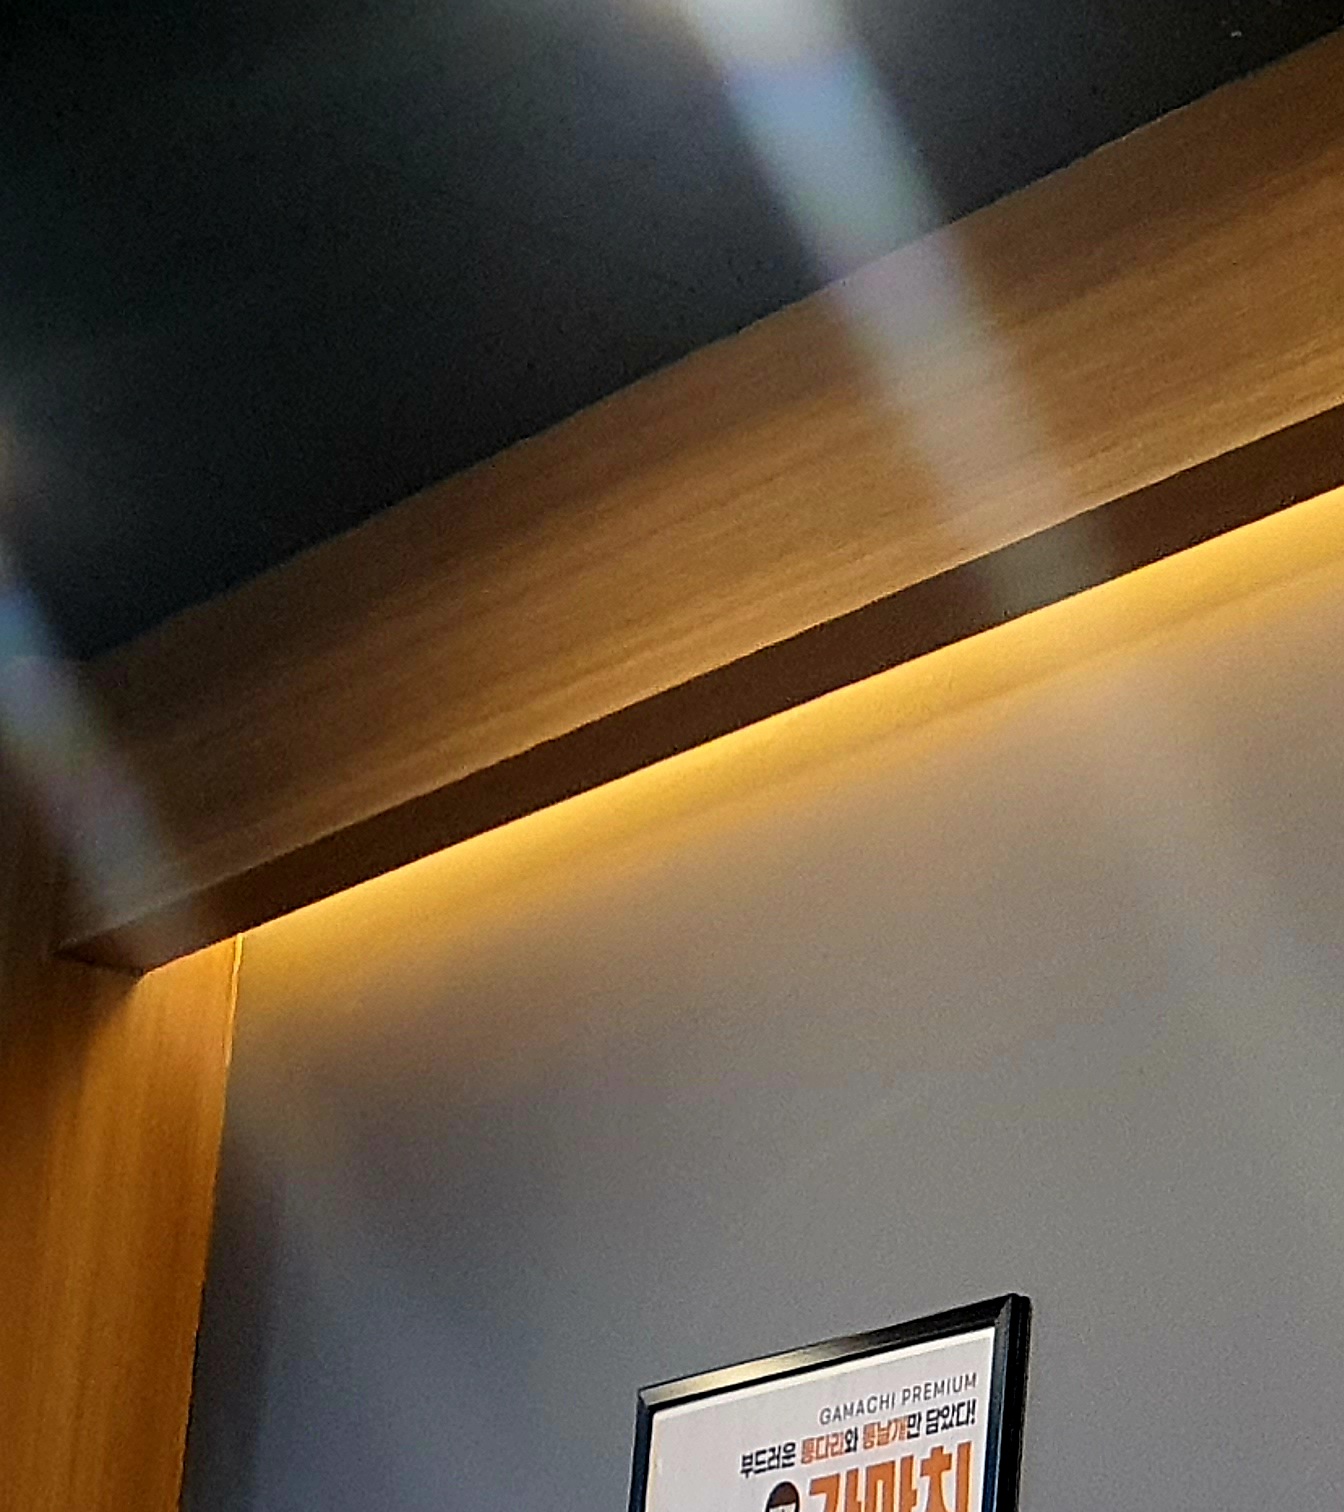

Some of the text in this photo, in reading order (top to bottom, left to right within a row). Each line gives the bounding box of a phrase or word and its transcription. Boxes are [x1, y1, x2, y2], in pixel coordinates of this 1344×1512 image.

[819, 1372, 977, 1425] GAMACHI PREMIUM
[740, 1441, 796, 1478] 부드러운
[925, 1398, 977, 1436] 담았다!
